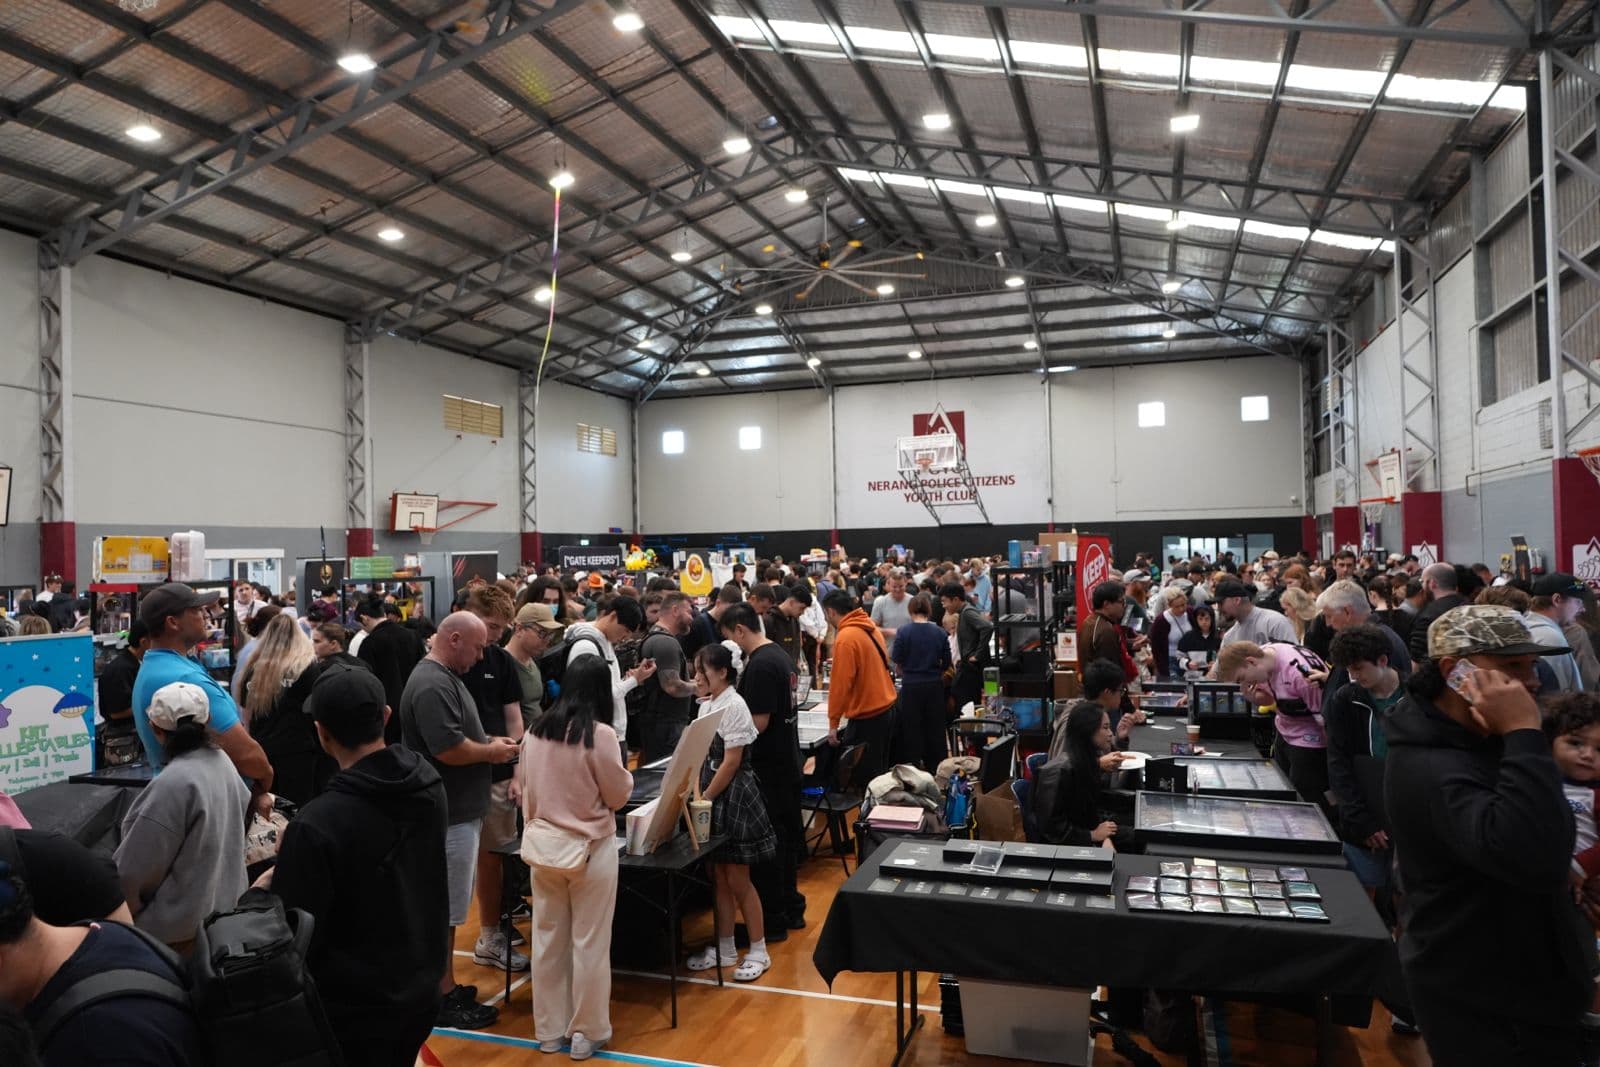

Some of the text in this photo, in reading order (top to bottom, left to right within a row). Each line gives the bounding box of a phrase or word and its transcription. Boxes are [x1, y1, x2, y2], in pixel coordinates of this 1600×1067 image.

[868, 475, 1016, 491] NERANG POLICE CITIZENS
[903, 490, 977, 503] YOUTH CLUB
[1083, 553, 1106, 588] KEEP
